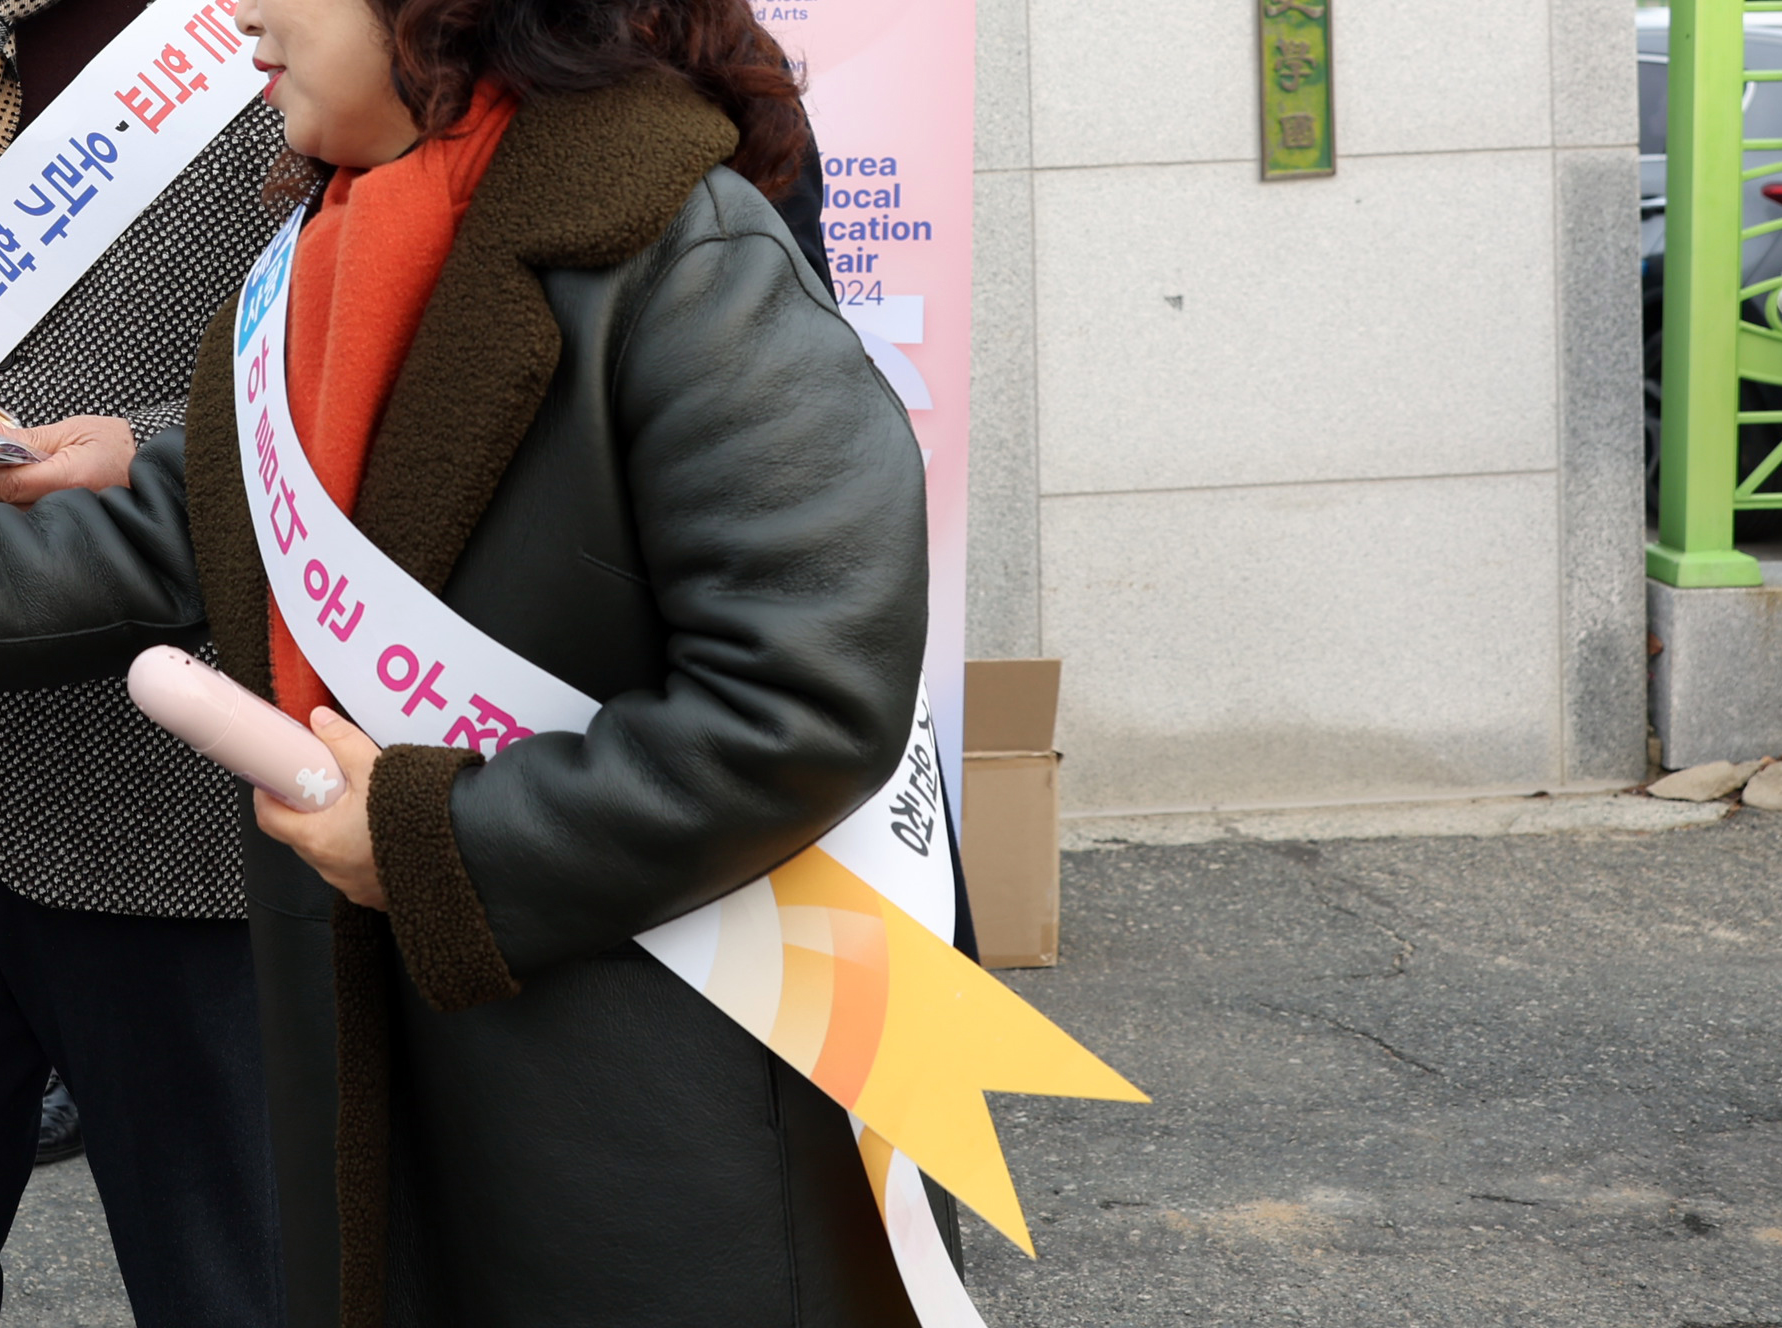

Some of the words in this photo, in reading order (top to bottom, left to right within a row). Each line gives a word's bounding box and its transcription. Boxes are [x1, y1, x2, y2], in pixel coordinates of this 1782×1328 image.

[771, 7, 809, 21] Arts
[819, 151, 898, 177] orea
[13, 132, 119, 247] 우리가
[822, 183, 901, 209] local
[820, 214, 933, 241] cation
[832, 279, 885, 306] 024
[246, 334, 366, 643] 아름다운
